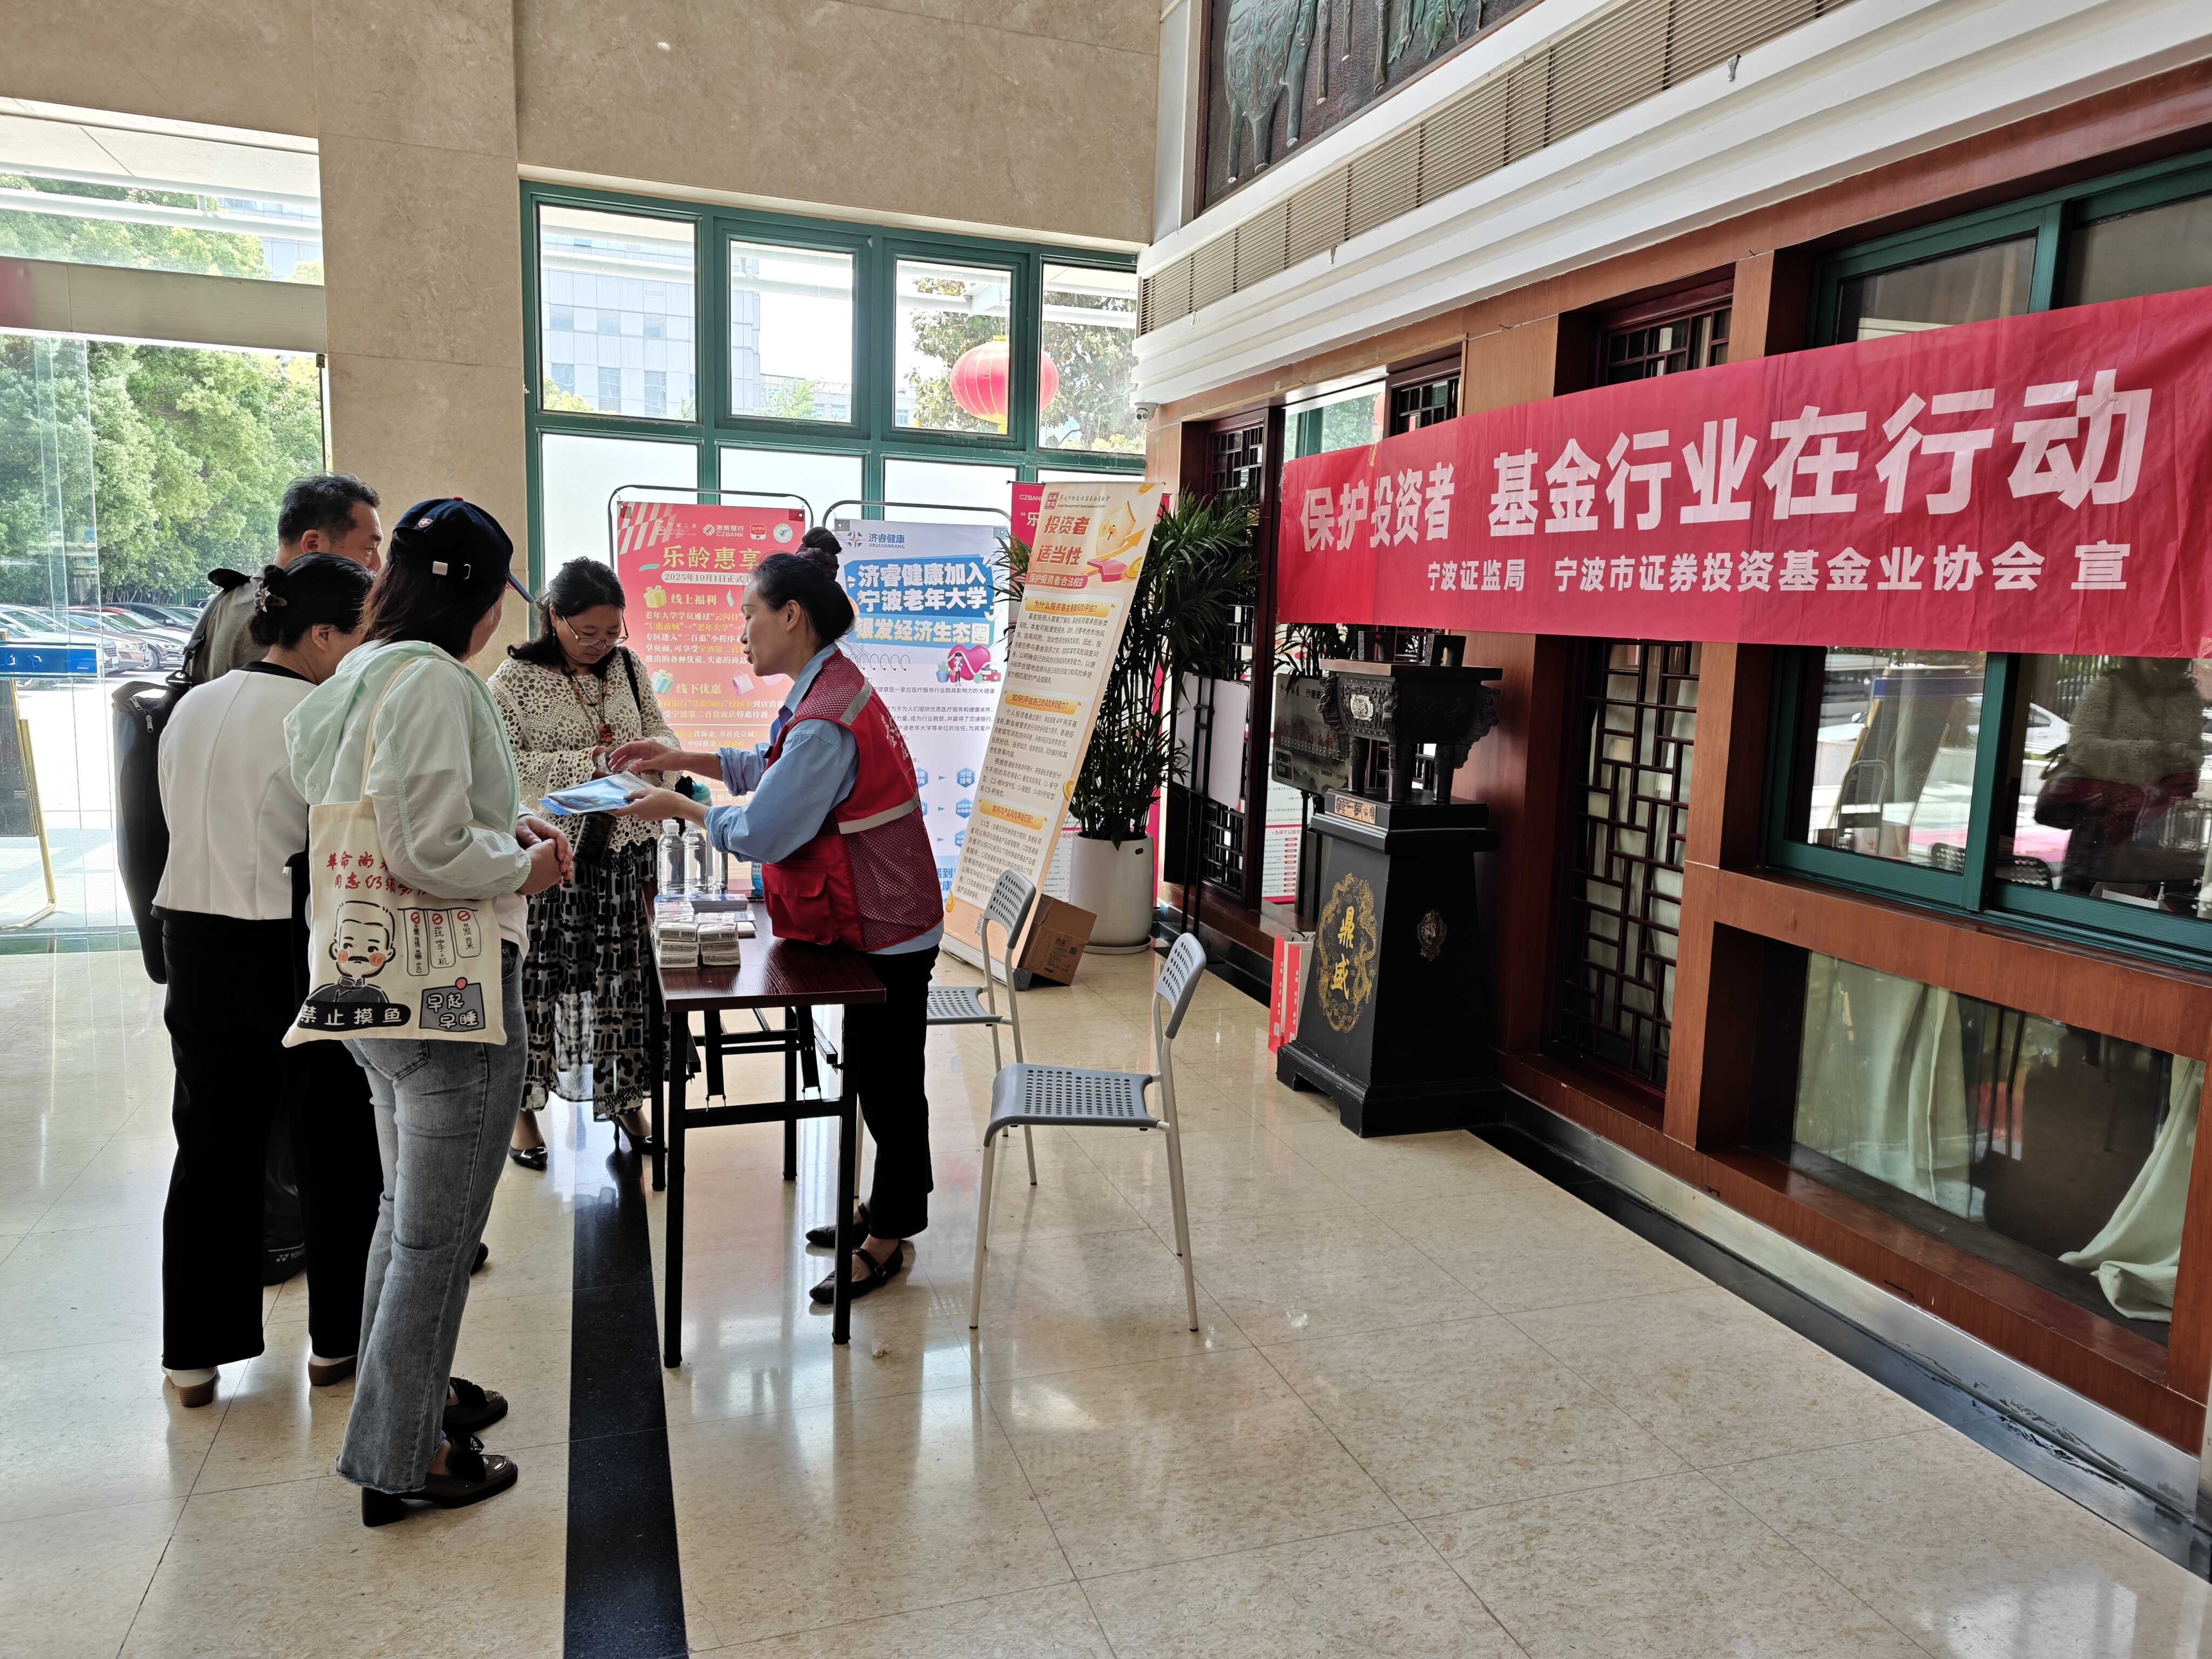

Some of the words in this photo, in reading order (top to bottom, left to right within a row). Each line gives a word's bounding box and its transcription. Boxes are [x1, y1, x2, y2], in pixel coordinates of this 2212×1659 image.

[1300, 461, 1454, 553] 保护投资者
[1488, 368, 2152, 539] 基金行业在行动
[716, 524, 744, 532] 浙商银行
[1043, 515, 1091, 535] 投资者
[868, 533, 905, 544] 济睿健康
[1036, 544, 1082, 565] 适当性
[858, 562, 986, 588] 济睿健康加入
[1427, 558, 1525, 593] 宁波证监局
[1554, 541, 2044, 594] 宁波市证券投资基金业协会
[2070, 539, 2129, 592] 宣
[1029, 574, 1084, 587] 保护投资者合法权益
[671, 594, 717, 605] 线上福利
[860, 586, 987, 612] 宁波老年大学
[676, 683, 722, 694] 线下优惠
[334, 872, 427, 896] 同志仍须努
[427, 993, 464, 1011] 早起
[300, 1005, 403, 1026] 禁止摸鱼
[439, 1010, 479, 1029] 早睡
